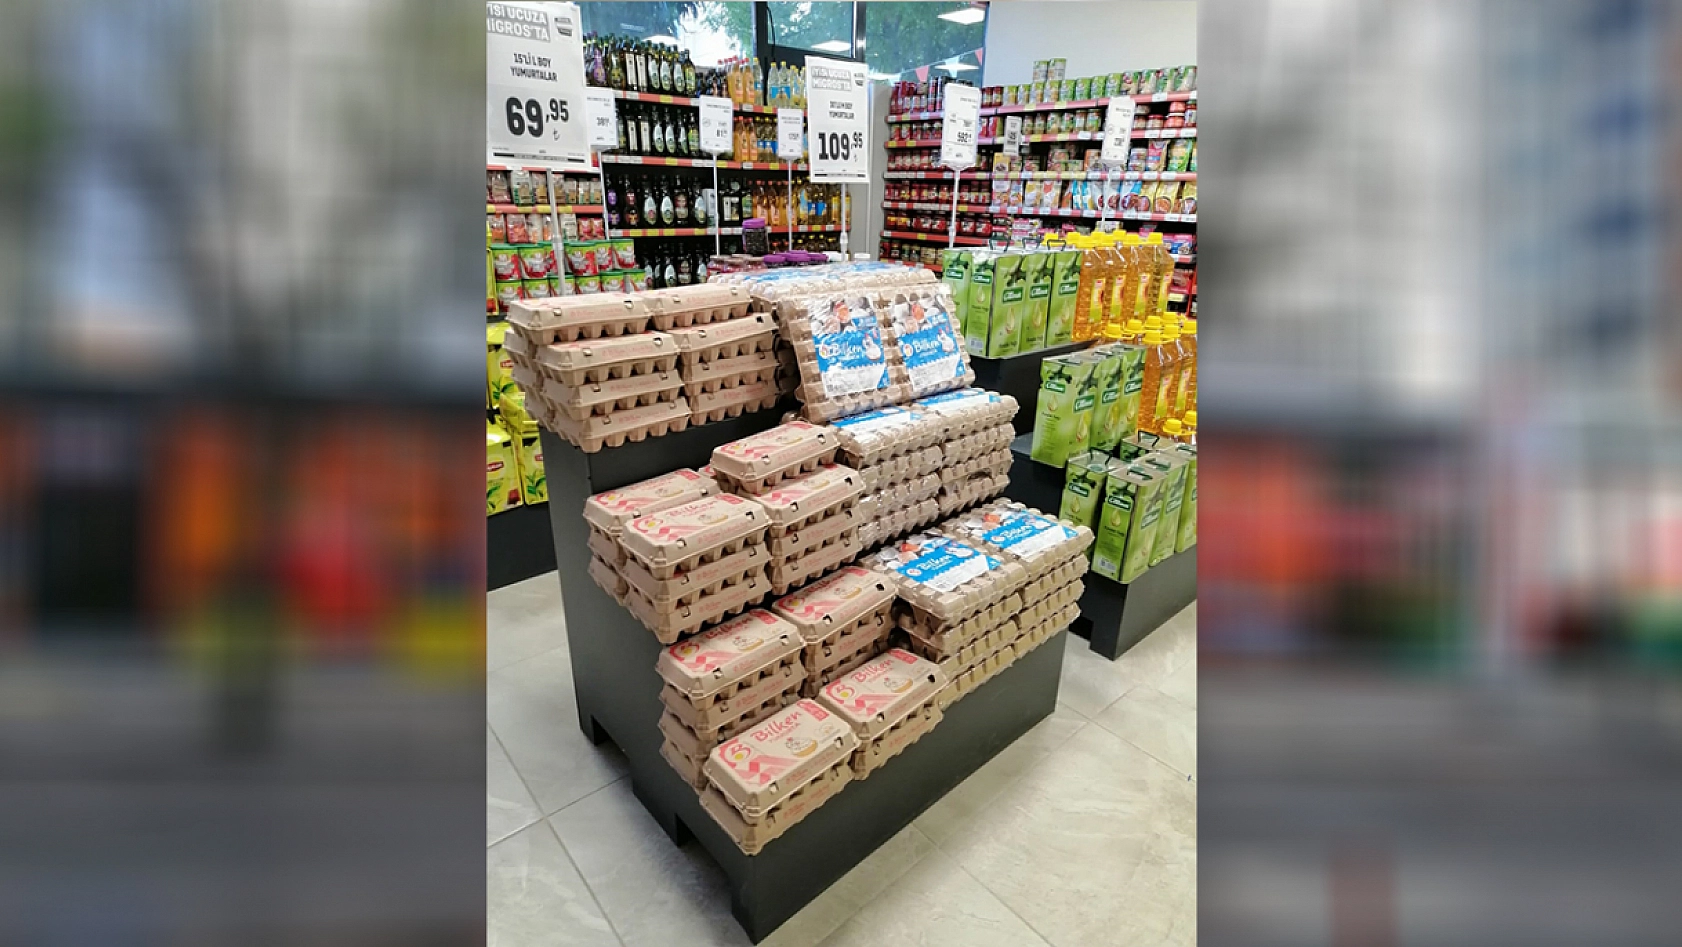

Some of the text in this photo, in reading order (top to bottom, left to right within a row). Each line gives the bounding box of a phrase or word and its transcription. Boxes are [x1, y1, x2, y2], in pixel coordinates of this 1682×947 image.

[507, 7, 547, 26] UCUZA
[538, 57, 552, 68] BOY
[510, 66, 558, 82] YUMURTALAR
[506, 96, 569, 138] 69,95
[849, 658, 896, 684] Bilken
[749, 710, 803, 742] Bilken
